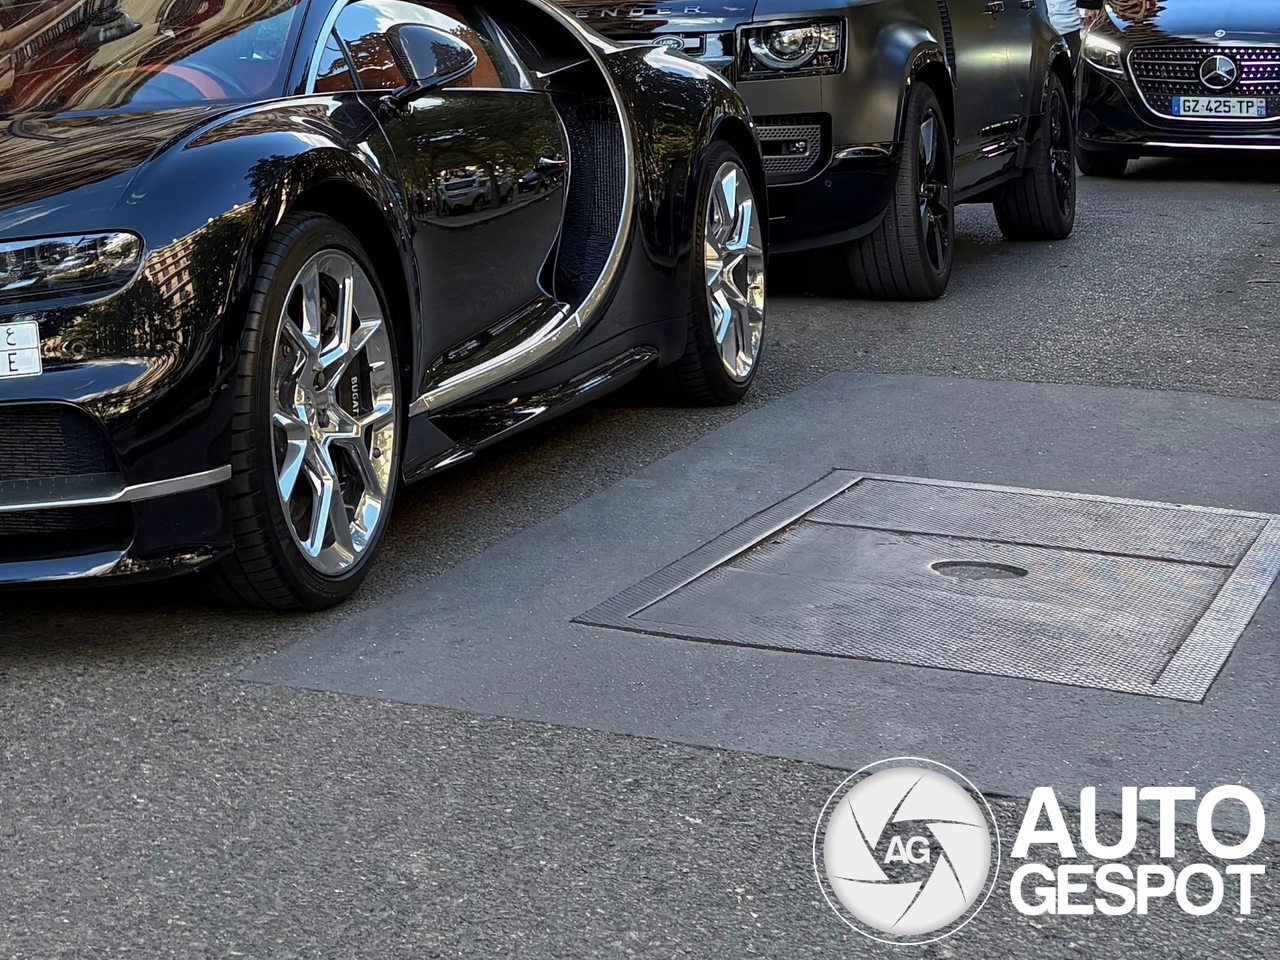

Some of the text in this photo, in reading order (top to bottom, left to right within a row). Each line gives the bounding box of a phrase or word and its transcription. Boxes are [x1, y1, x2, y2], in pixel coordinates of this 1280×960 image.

[575, 5, 709, 18] ENDER
[1182, 99, 1254, 114] GZ-425-TP
[350, 376, 360, 418] BUGAT
